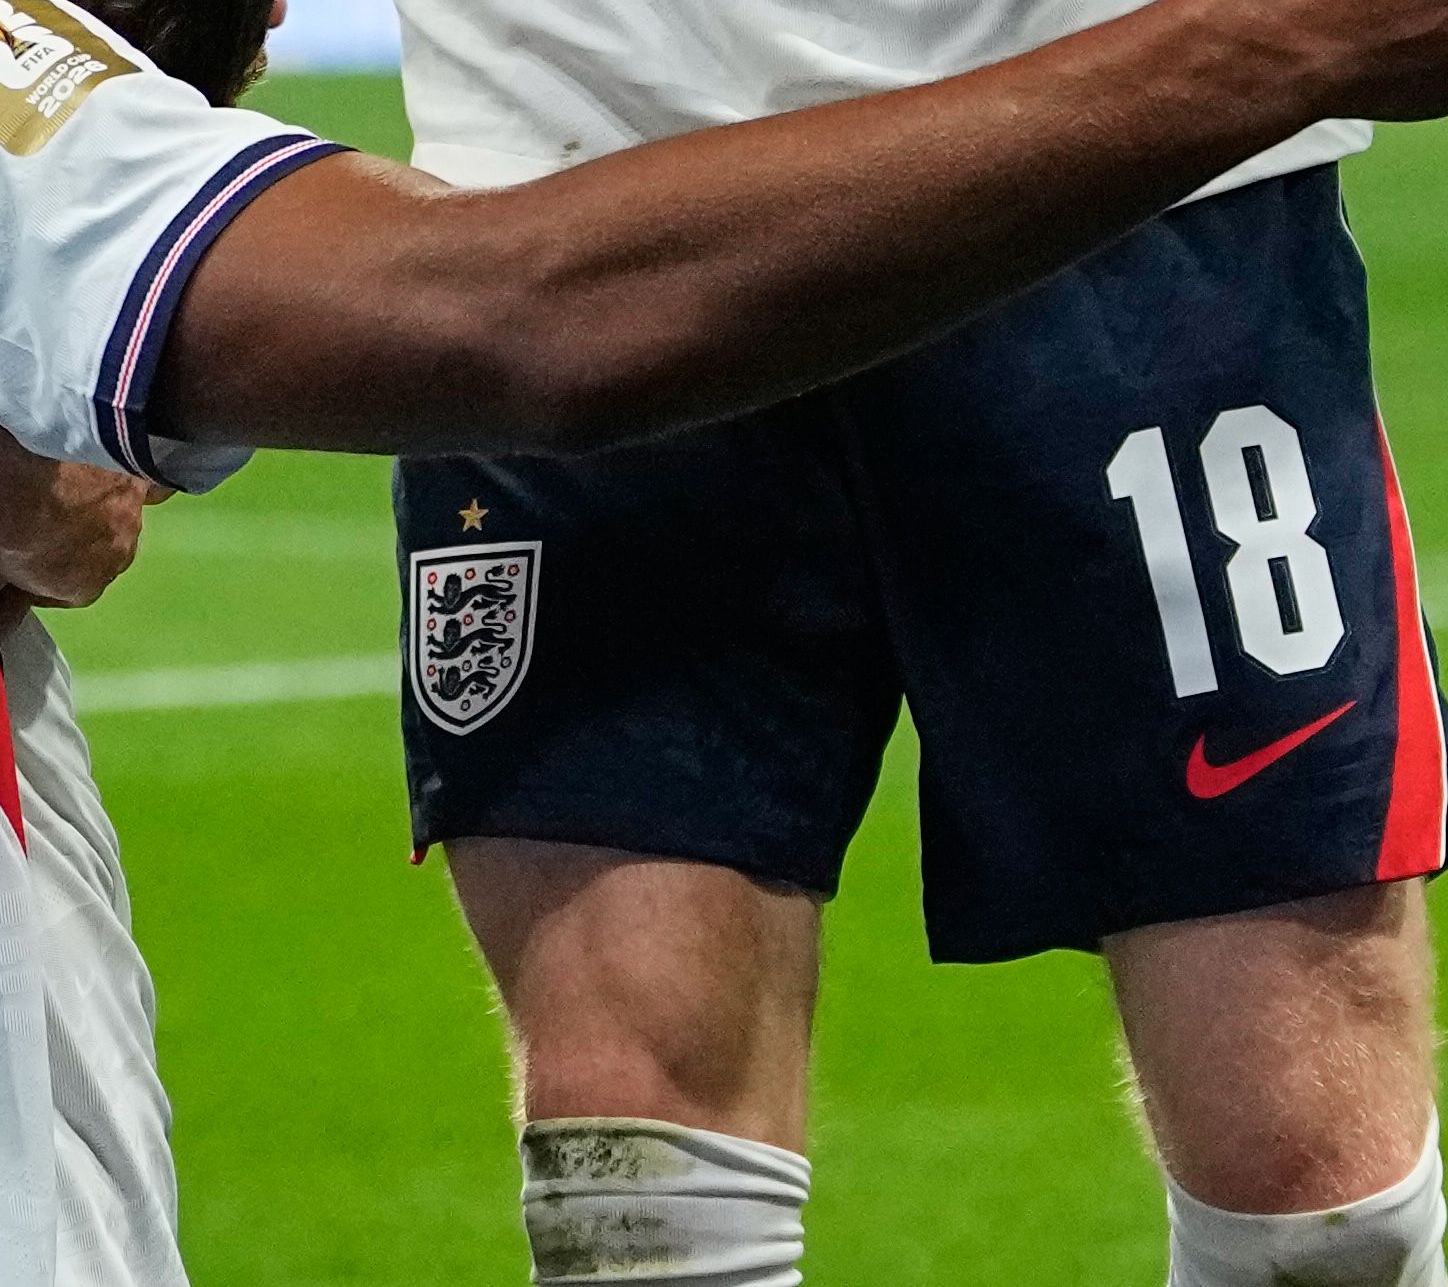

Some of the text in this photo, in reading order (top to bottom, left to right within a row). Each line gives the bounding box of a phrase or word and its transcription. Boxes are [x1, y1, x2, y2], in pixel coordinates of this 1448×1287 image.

[20, 46, 55, 72] FIFA
[25, 63, 69, 105] WORLD
[37, 59, 108, 119] 2026
[1105, 403, 1347, 700] 18
